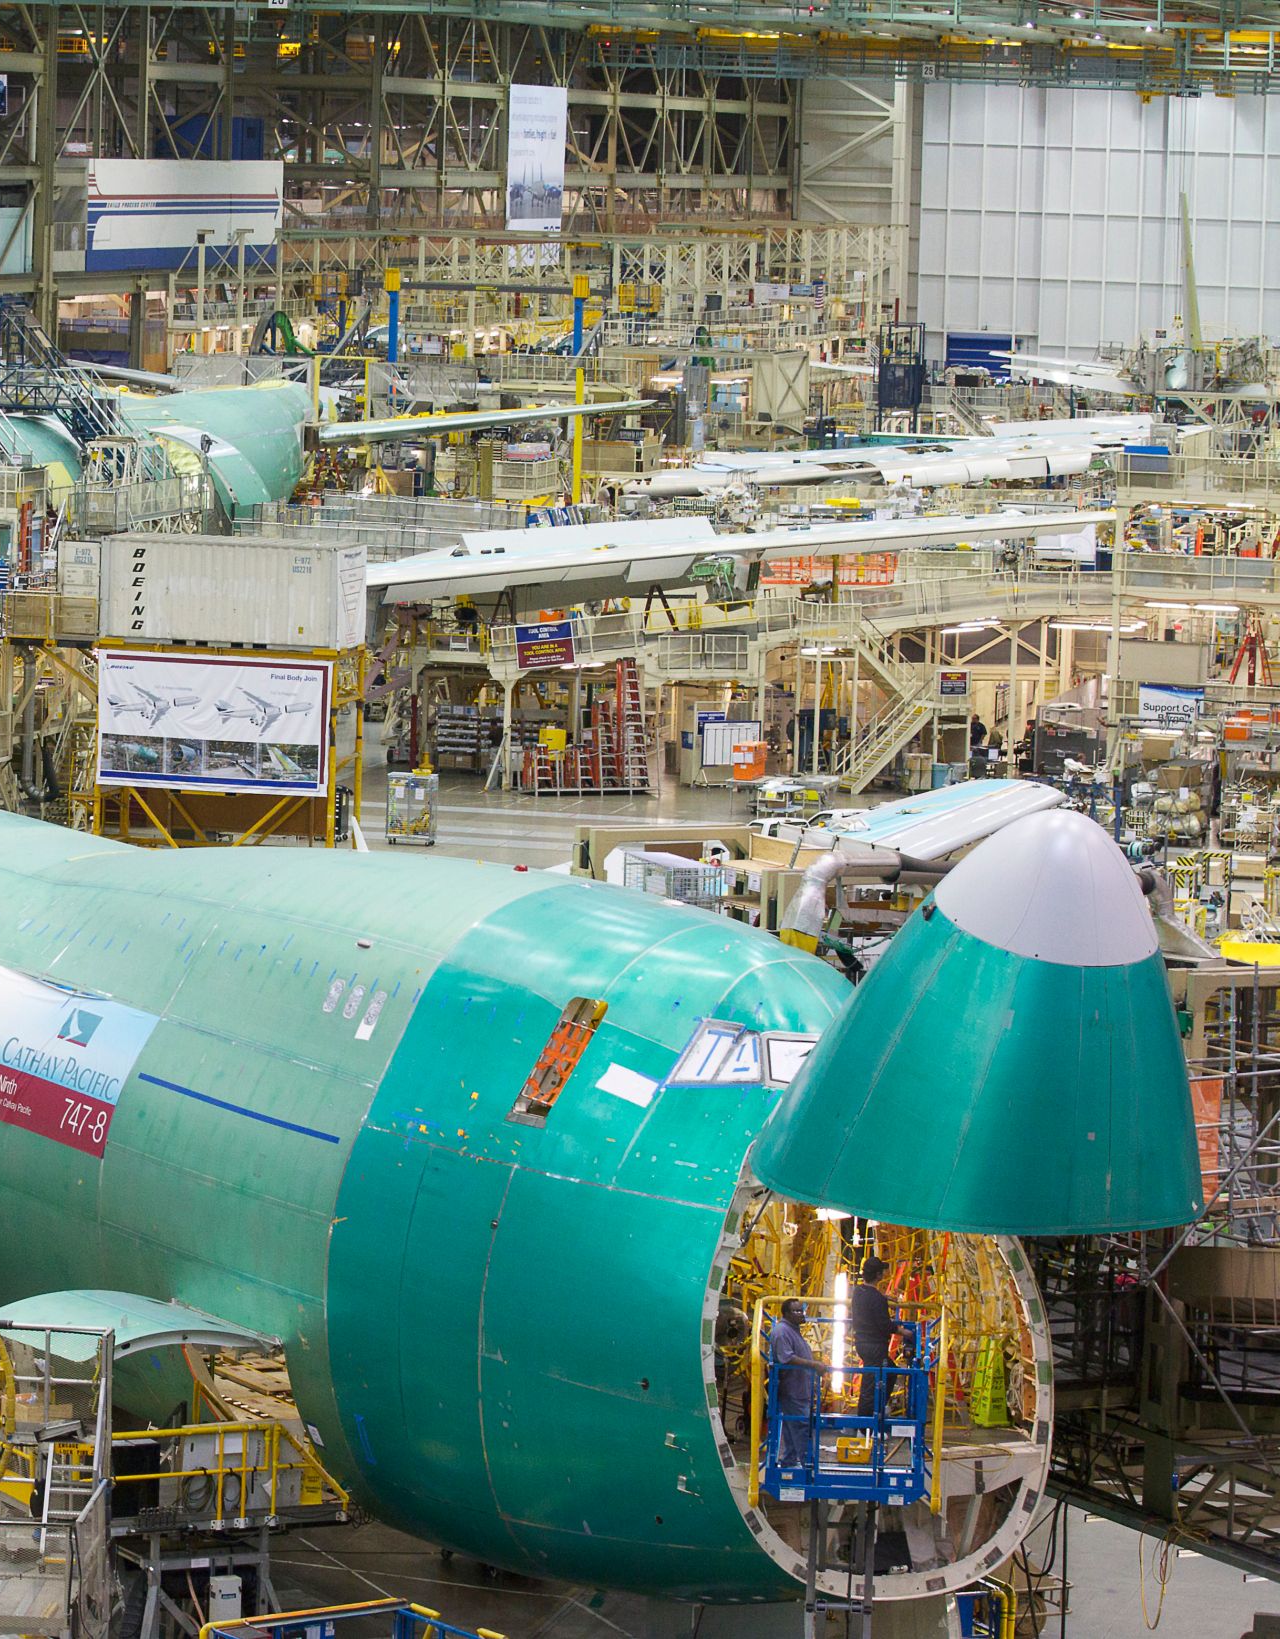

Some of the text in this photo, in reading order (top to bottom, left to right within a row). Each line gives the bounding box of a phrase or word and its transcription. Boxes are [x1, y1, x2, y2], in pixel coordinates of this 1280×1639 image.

[924, 66, 934, 76] 25
[131, 548, 146, 631] BOEING
[287, 674, 303, 682] Body
[1143, 702, 1179, 712] Support
[1158, 713, 1185, 724] Brge
[2, 1036, 119, 1101] CATHAY PACIFIC
[3, 1098, 18, 1112] Cathay
[17, 1103, 32, 1116] Pacific
[60, 1098, 108, 1143] 747-8
